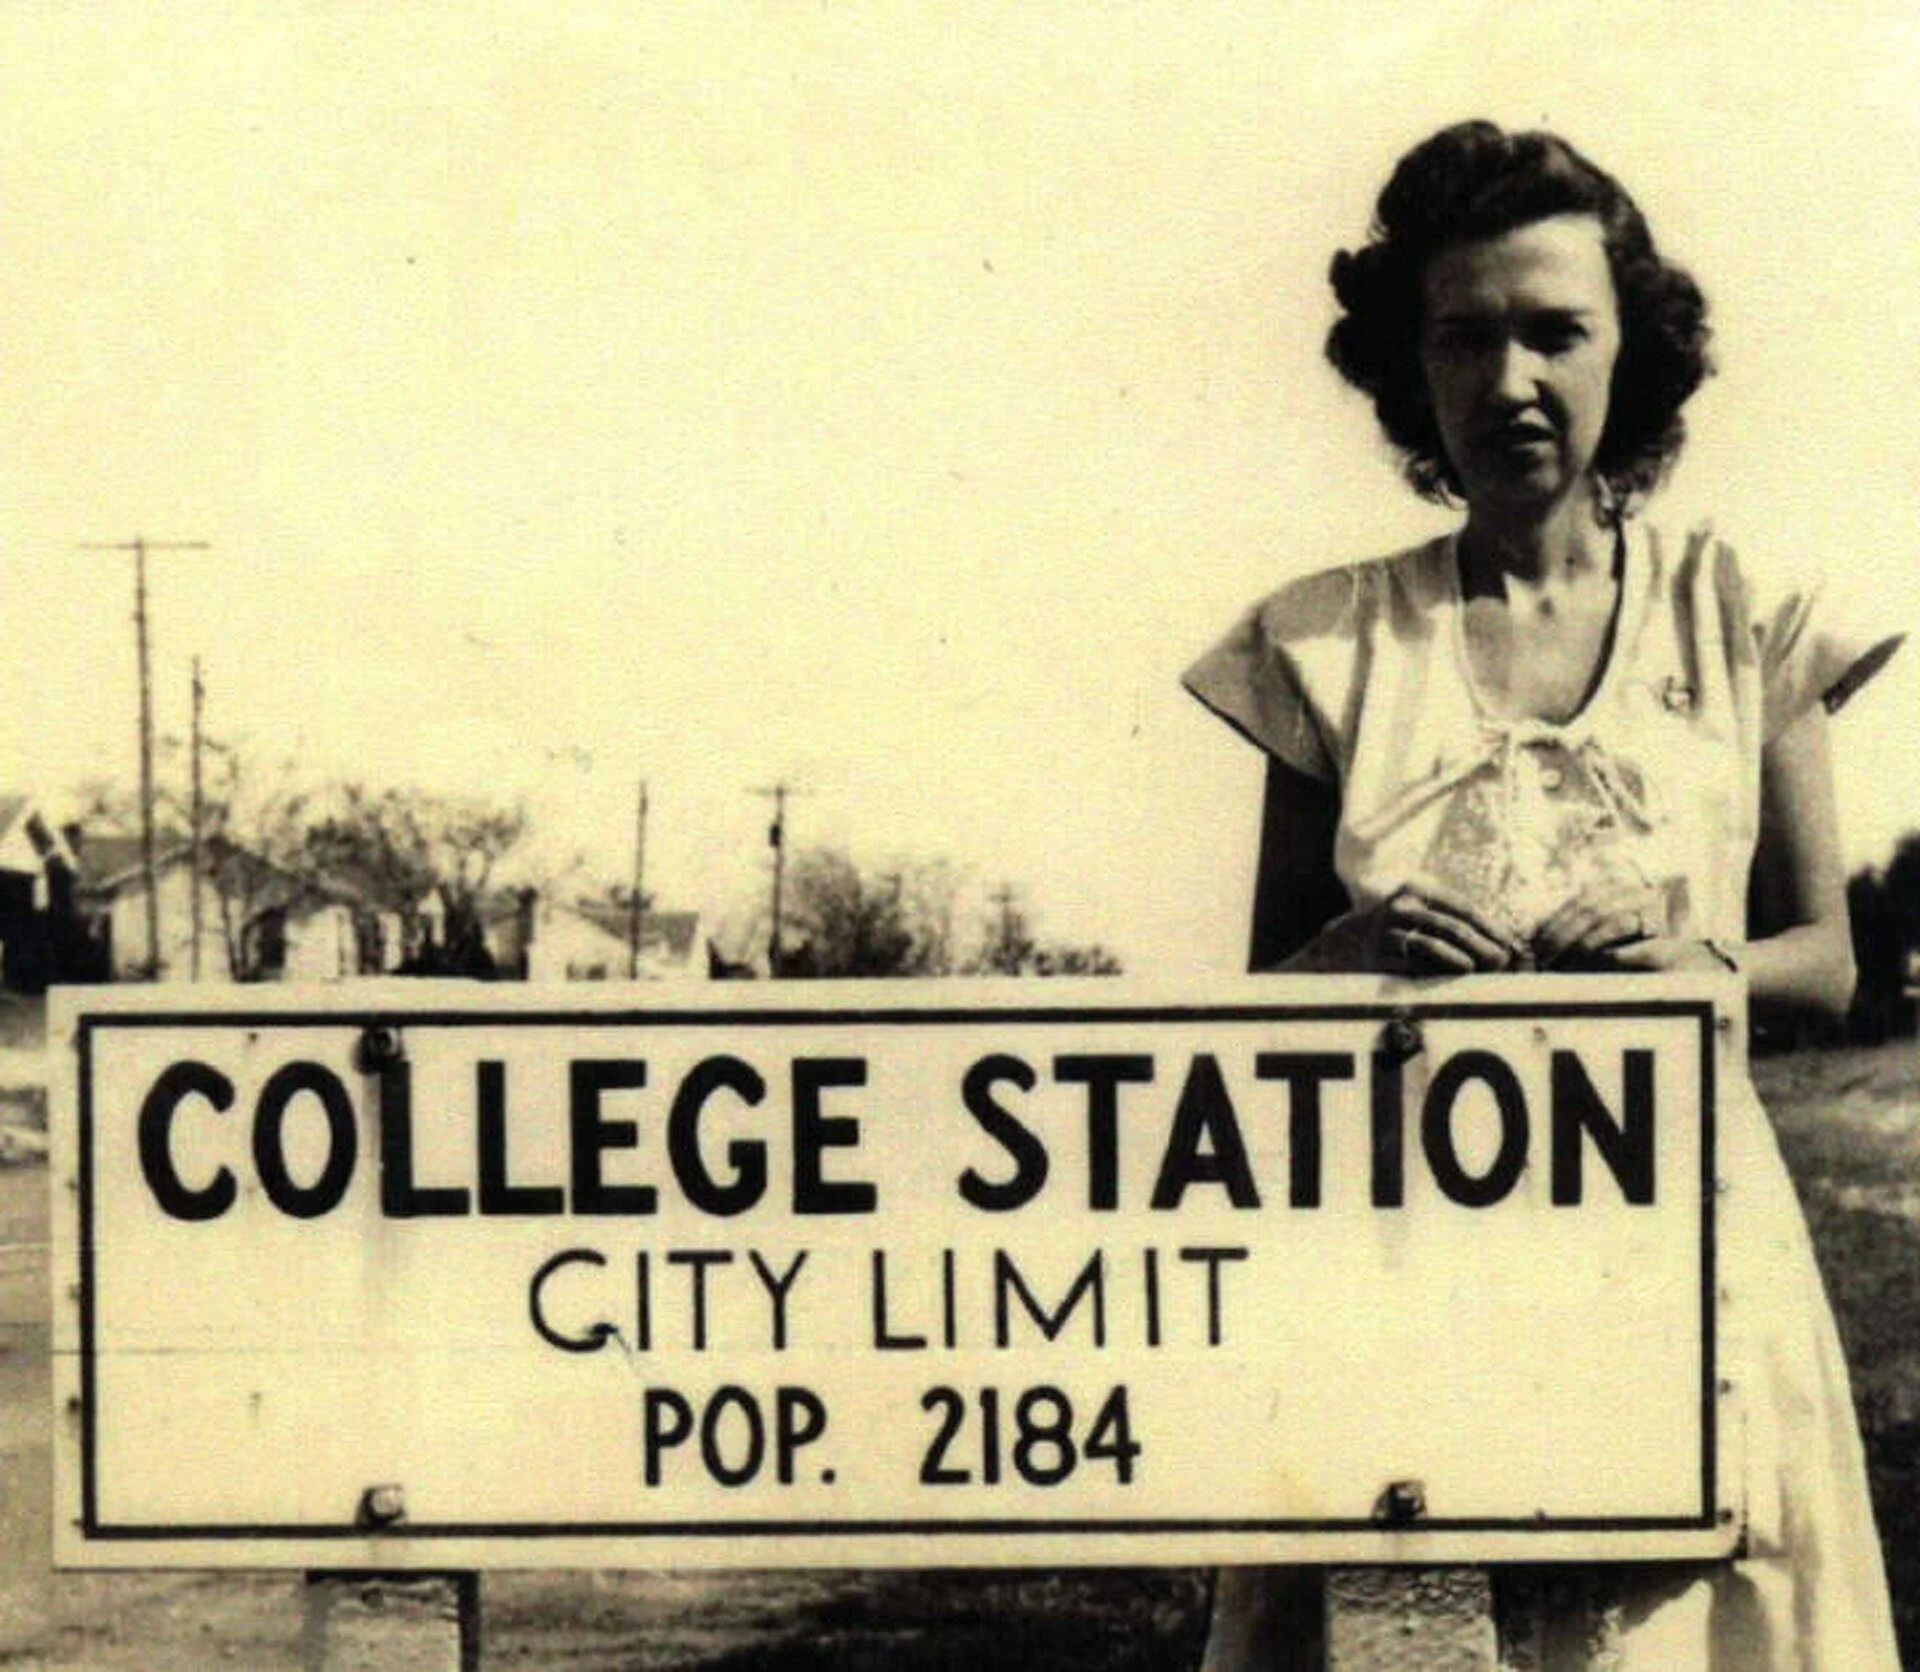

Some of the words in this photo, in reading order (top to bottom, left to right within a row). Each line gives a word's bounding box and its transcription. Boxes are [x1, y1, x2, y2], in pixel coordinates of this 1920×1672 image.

[137, 1055, 878, 1222] COLLEGE
[957, 1049, 1656, 1212] STATION
[529, 1248, 809, 1353] CITY
[872, 1247, 1249, 1350] LIMIT
[643, 1385, 837, 1488] POP.
[919, 1384, 1142, 1487] 2184
